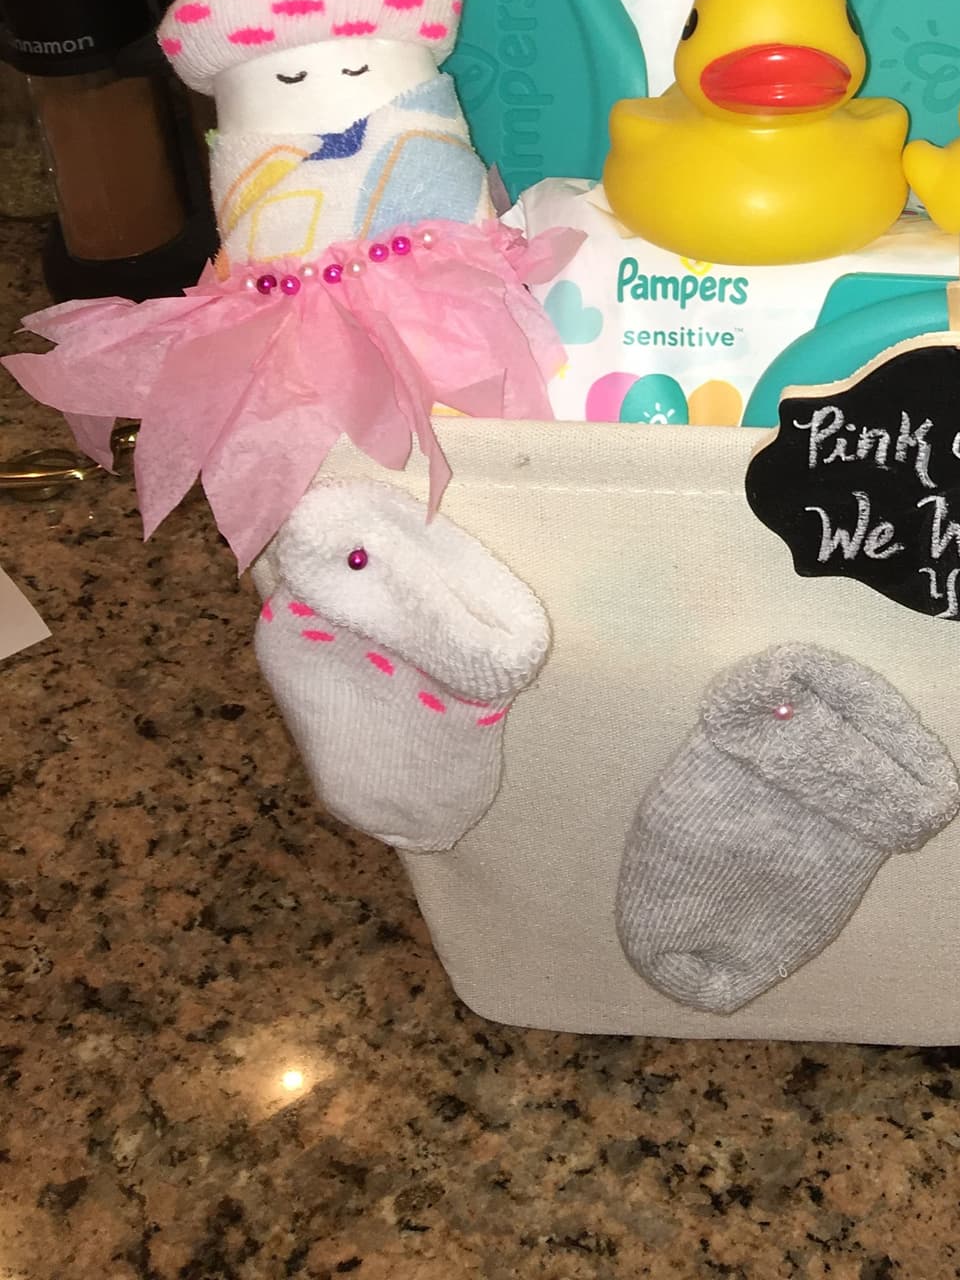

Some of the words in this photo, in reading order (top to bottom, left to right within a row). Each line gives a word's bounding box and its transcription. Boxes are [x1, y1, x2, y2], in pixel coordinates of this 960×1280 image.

[617, 257, 749, 310] Pampers
[793, 405, 936, 488] Pink
[805, 490, 904, 563] We
